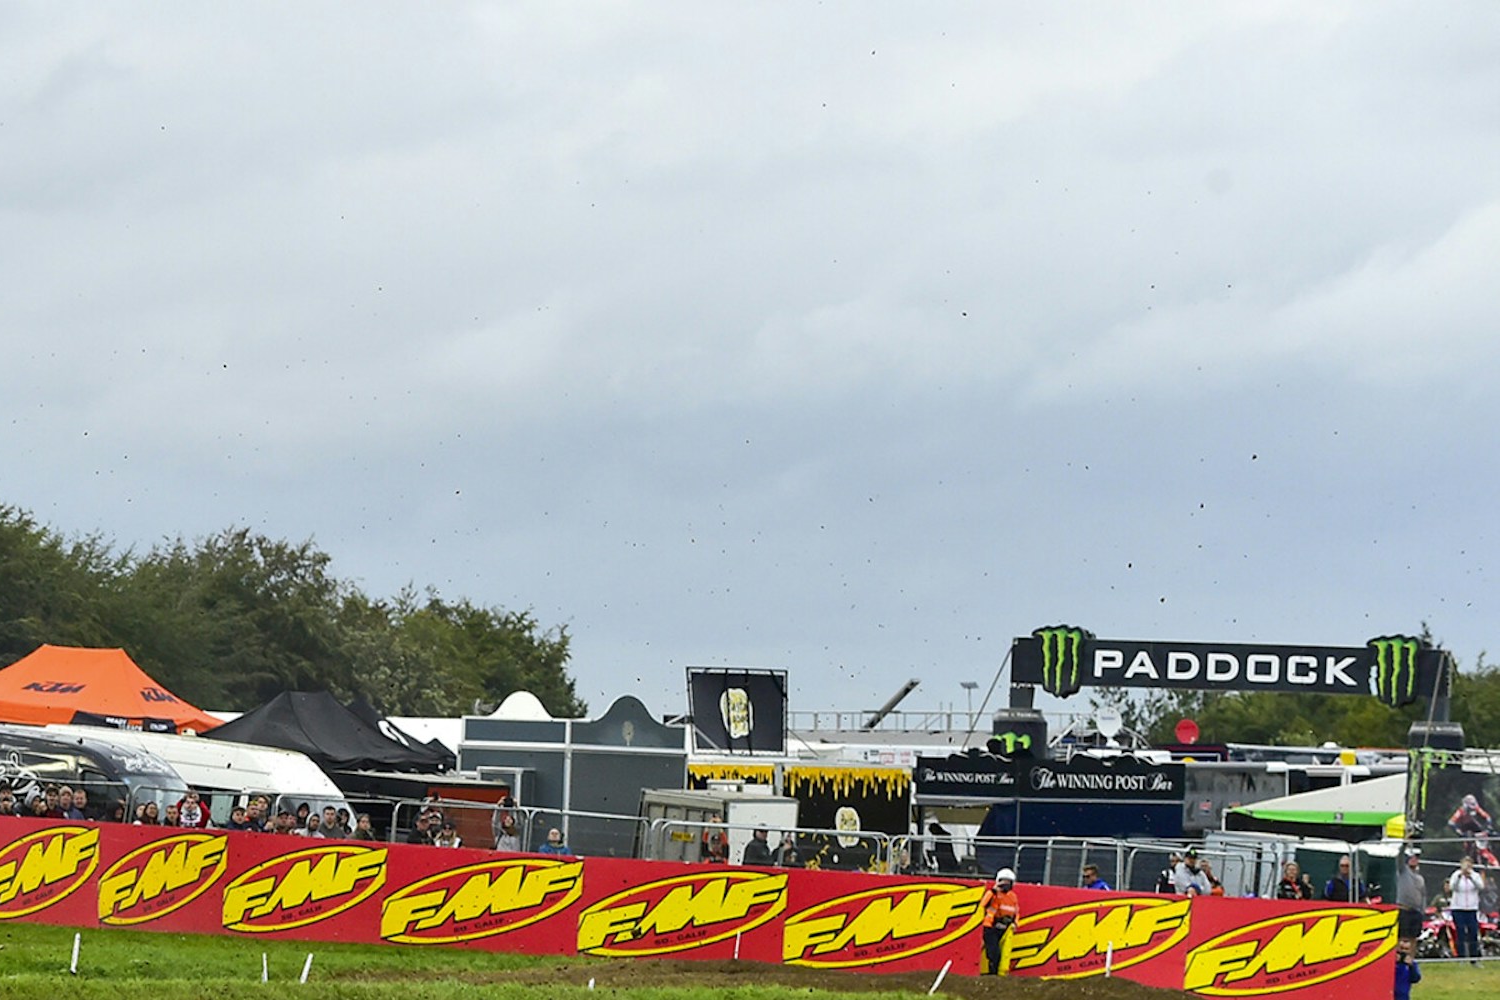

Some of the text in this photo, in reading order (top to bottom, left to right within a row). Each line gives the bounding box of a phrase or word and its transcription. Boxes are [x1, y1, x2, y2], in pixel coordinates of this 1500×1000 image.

[21, 681, 87, 694] KTM
[139, 687, 179, 704] KTM
[1094, 649, 1358, 686] PADDOCK
[937, 772, 974, 784] WINNING
[974, 774, 997, 784] POST
[1033, 766, 1173, 791] The WINNING POST Bar
[98, 835, 228, 920] FMF
[222, 848, 389, 927] FMF
[380, 861, 584, 939] FMF
[577, 873, 789, 952] FMF
[782, 886, 986, 964] FMF
[1009, 899, 1192, 973] FMF
[1184, 909, 1400, 990] FMF
